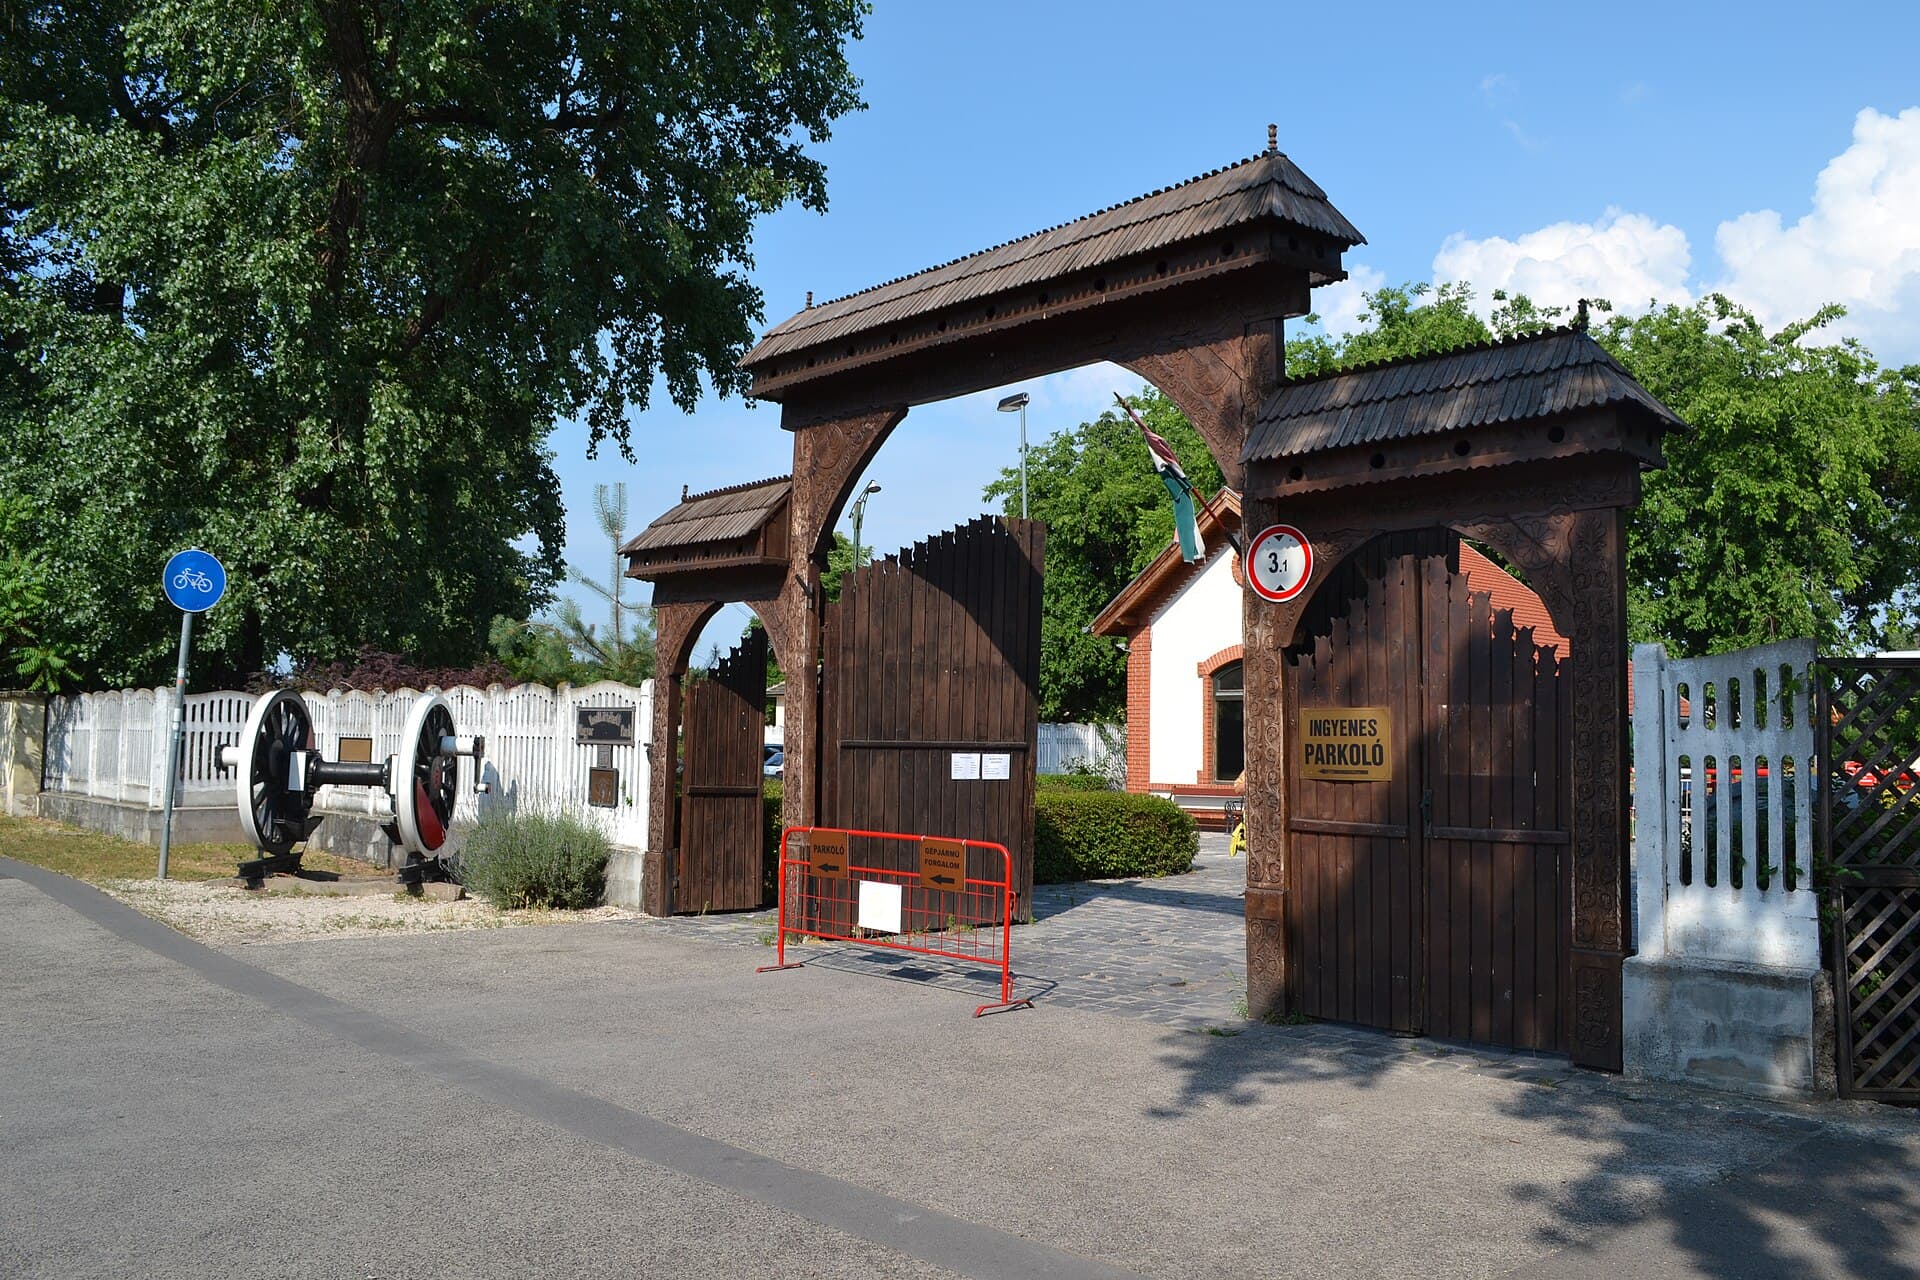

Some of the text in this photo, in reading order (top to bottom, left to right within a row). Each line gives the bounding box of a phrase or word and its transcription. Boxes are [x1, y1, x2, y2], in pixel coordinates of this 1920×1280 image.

[1268, 552, 1288, 573] 3.1
[1309, 719, 1378, 737] INGYENES
[1304, 738, 1384, 767] PARKOLÓ
[813, 843, 845, 856] PARKOLÓ
[924, 858, 960, 870] FORGALOM
